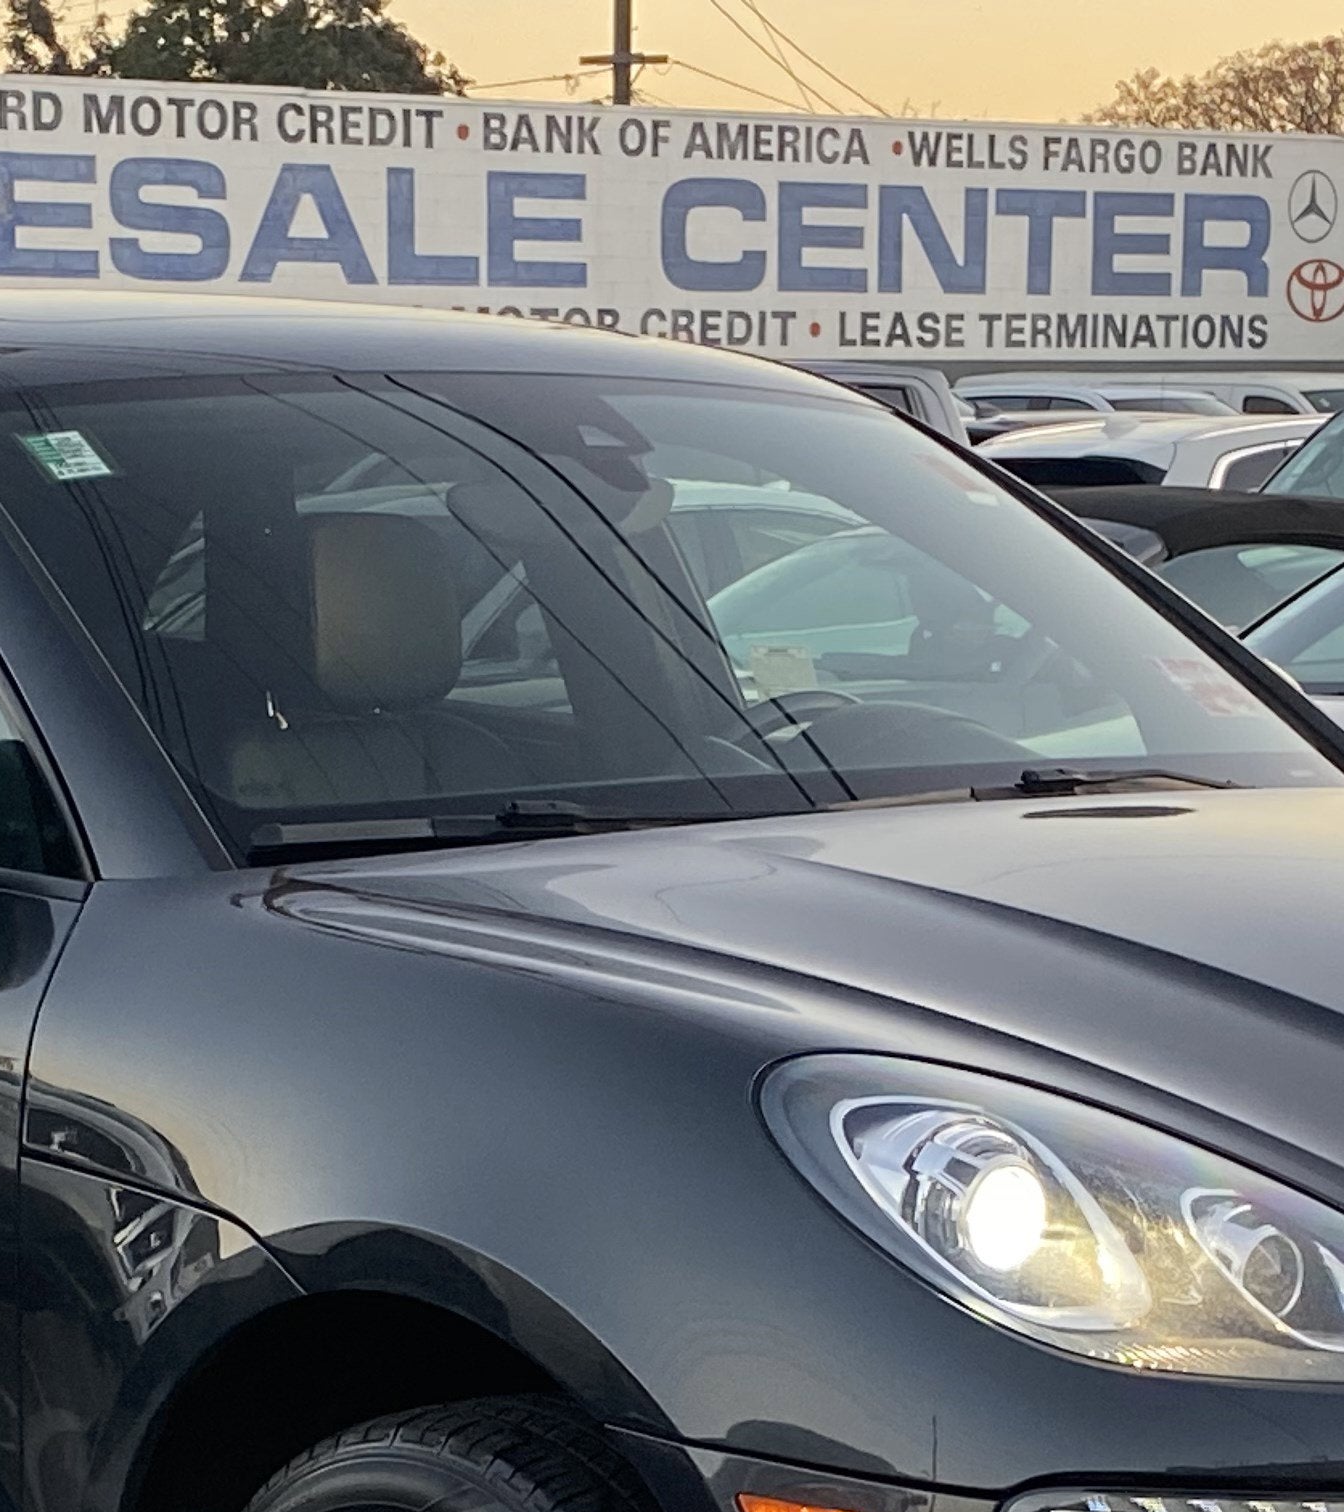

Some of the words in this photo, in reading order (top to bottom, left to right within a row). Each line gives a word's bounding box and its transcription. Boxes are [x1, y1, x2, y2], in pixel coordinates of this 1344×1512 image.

[83, 94, 258, 142] MOTOR
[277, 103, 444, 150] CREDIT
[483, 112, 602, 156] BANK
[619, 118, 670, 158] OF
[683, 122, 870, 167] AMERICA
[907, 130, 1029, 172] WELLS
[1043, 138, 1162, 176] FARGO
[1177, 142, 1274, 180] BANK
[660, 177, 1272, 298] CENTER
[639, 308, 797, 348] CREDIT
[838, 310, 965, 348] LEASE
[979, 313, 1269, 350] TERMINATIONS
